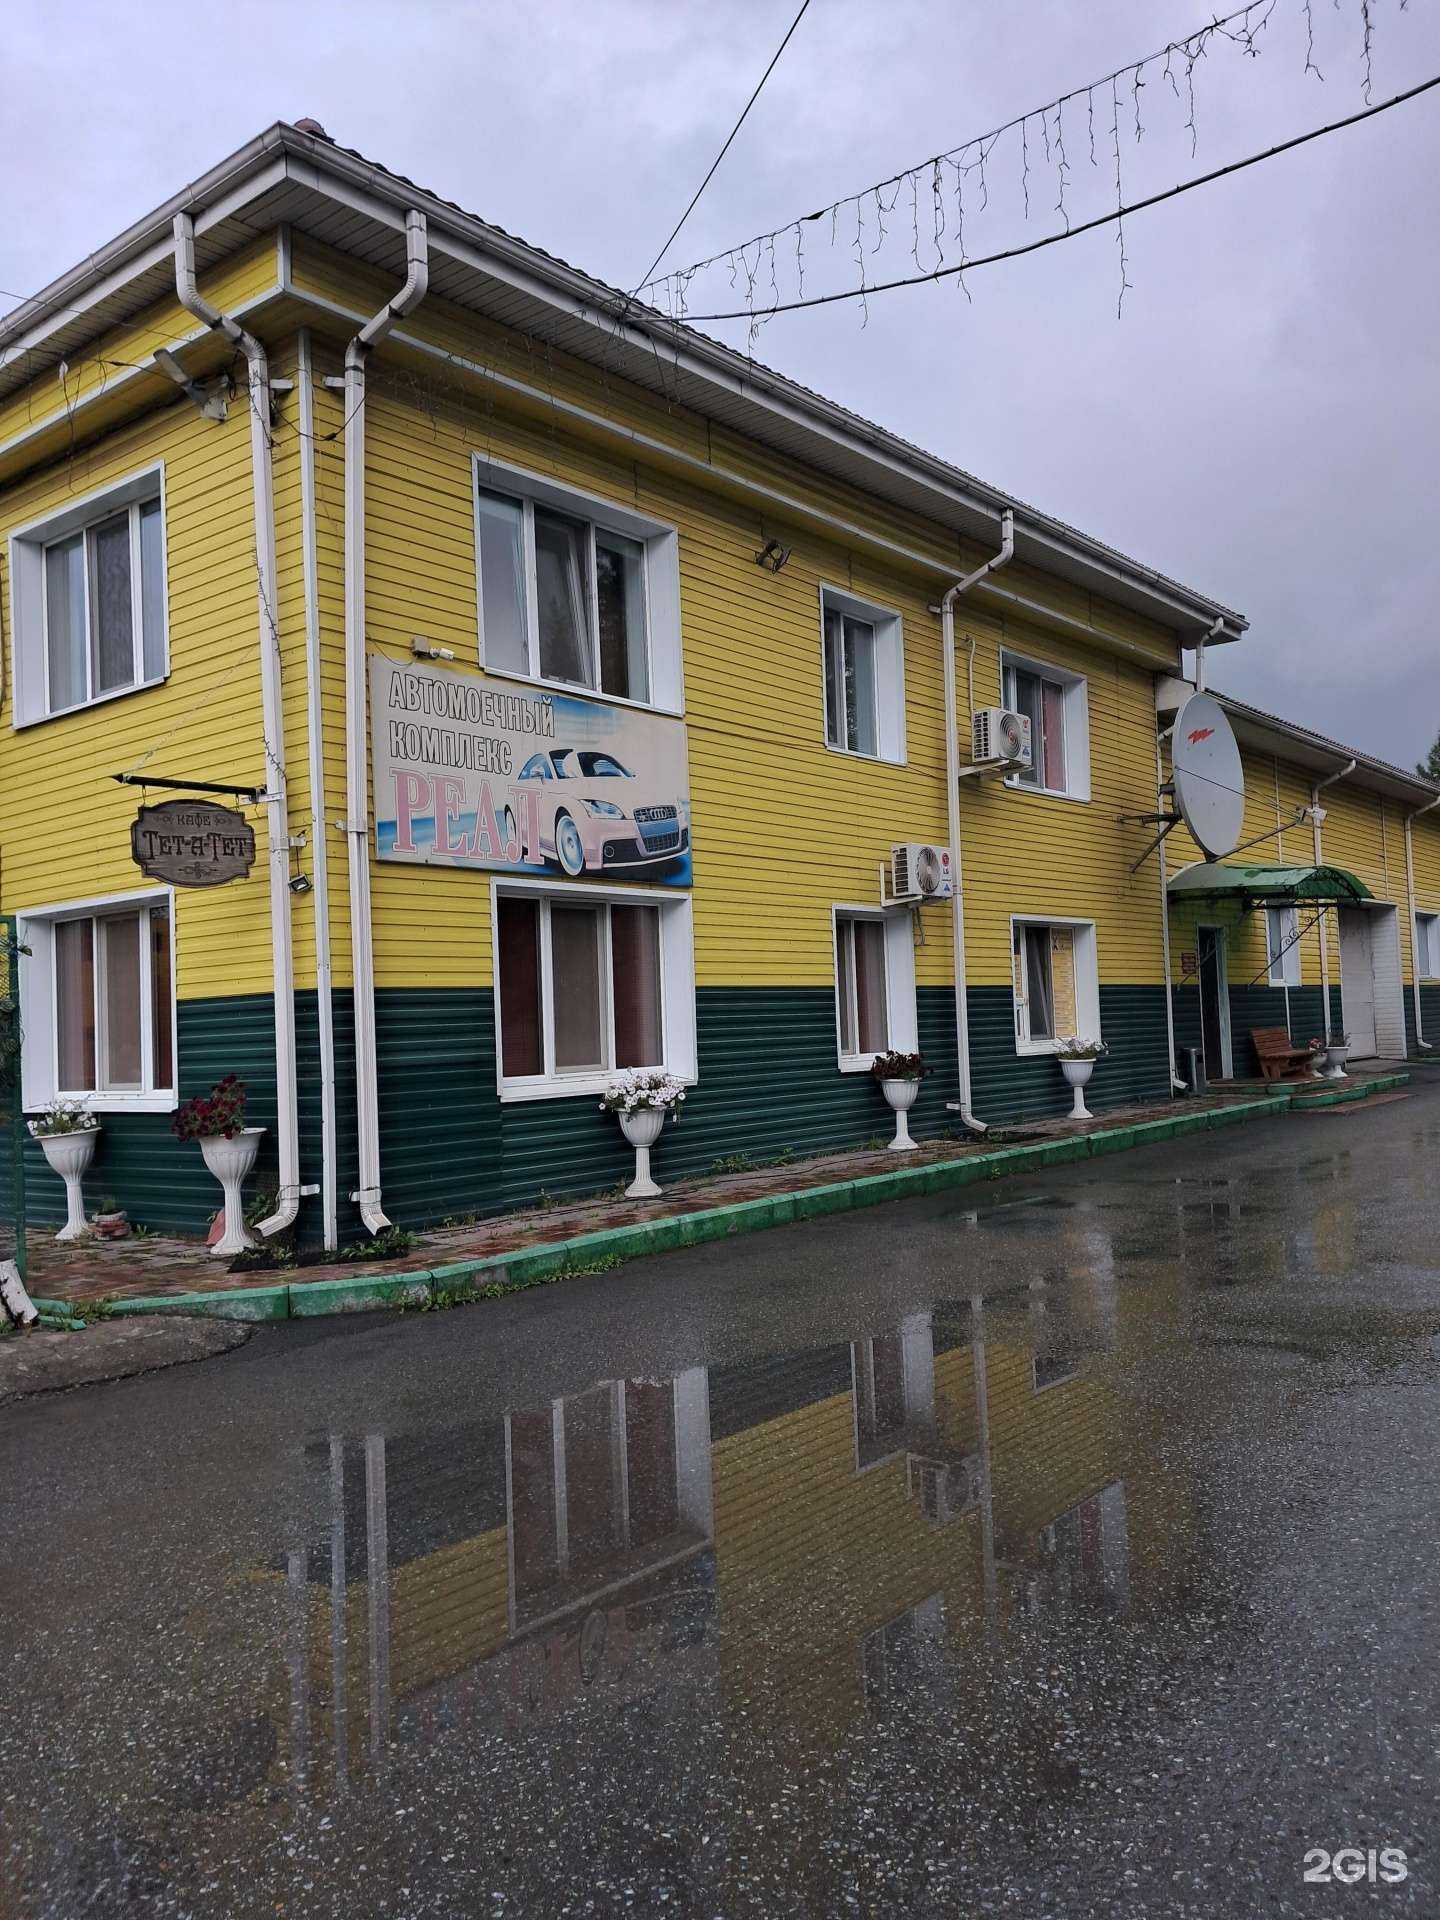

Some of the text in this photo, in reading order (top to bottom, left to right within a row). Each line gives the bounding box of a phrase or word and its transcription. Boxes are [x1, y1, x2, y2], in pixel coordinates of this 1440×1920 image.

[388, 670, 555, 738] АВТОМОЕЧНЫЙ
[388, 719, 513, 776] КОМПЛЕКС
[177, 813, 212, 828] КАФЕ
[388, 766, 546, 866] РЕАЛ
